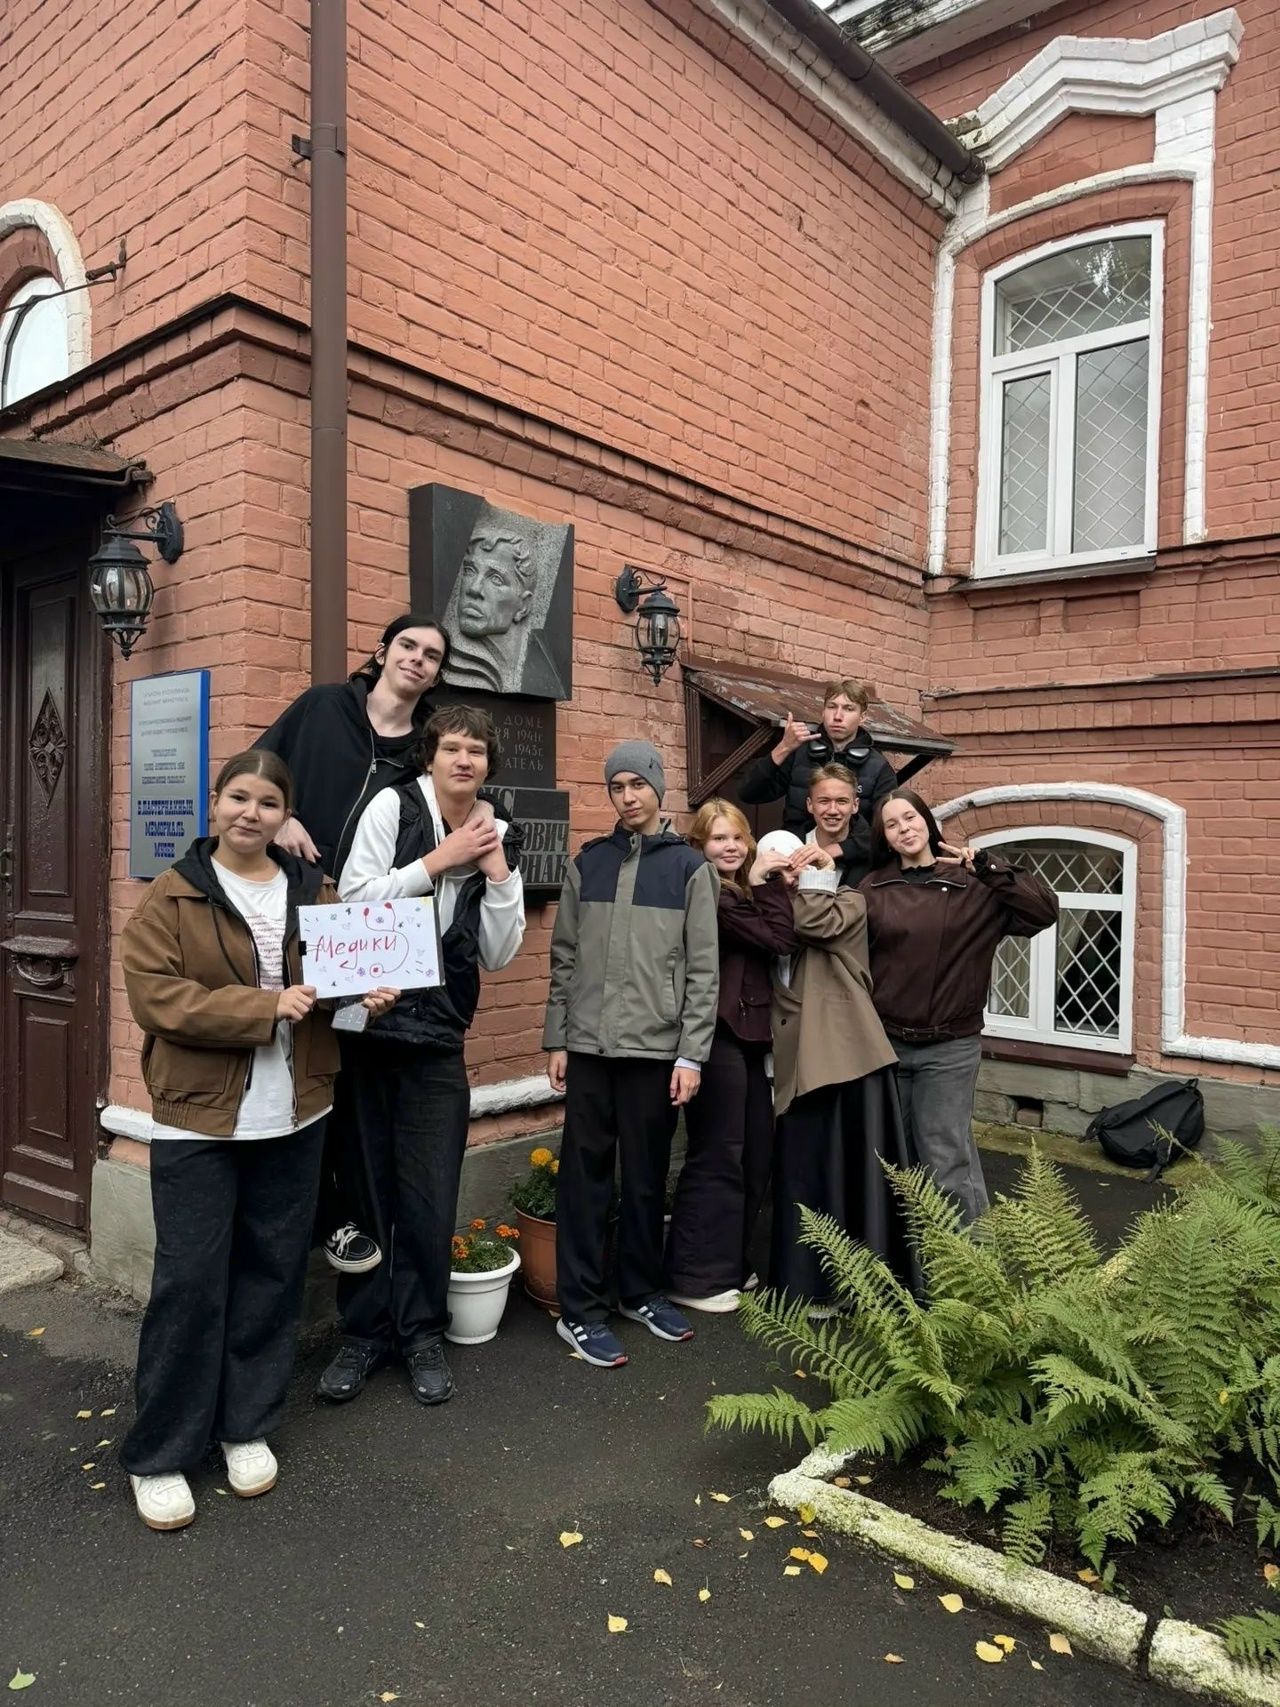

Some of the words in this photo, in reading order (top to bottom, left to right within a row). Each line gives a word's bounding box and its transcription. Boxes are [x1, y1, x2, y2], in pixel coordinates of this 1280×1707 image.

[503, 713, 543, 729] ДОМЕ
[504, 757, 544, 772] АТЕЛЬ
[315, 934, 398, 970] Медики
